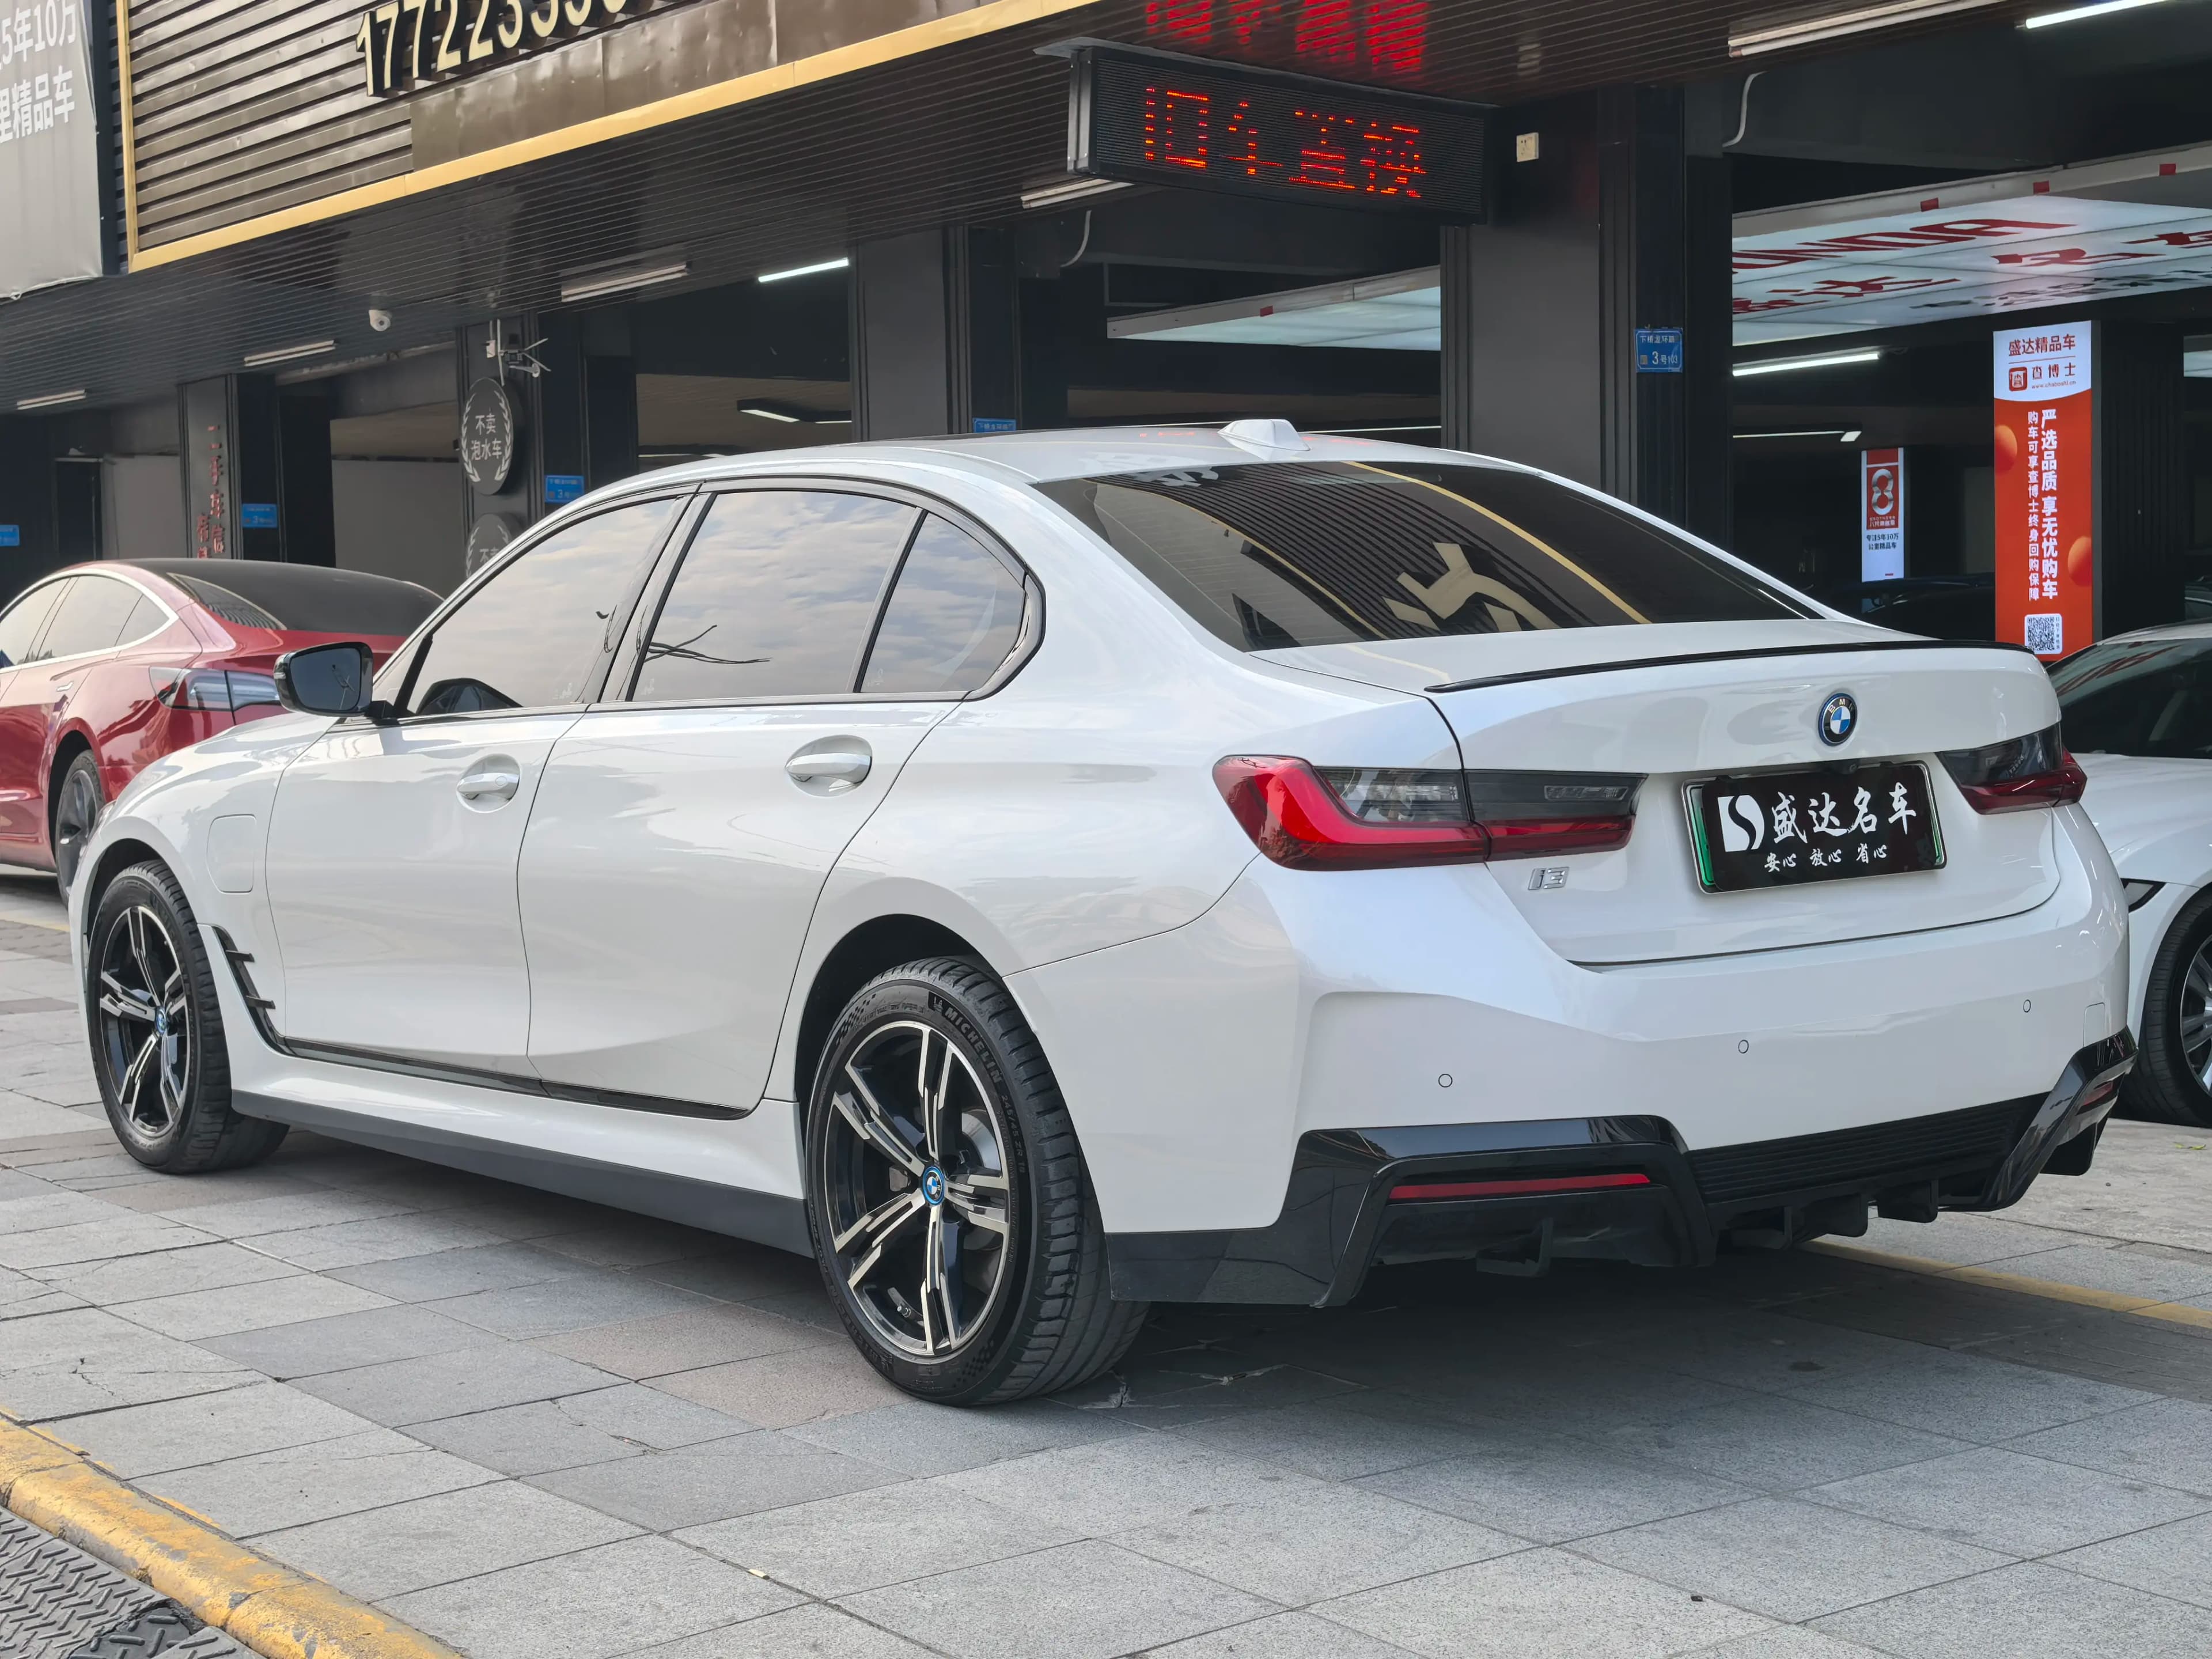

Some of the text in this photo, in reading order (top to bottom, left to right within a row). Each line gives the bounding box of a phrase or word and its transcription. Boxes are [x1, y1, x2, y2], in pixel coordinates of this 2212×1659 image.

[2009, 334, 2075, 357] 盛达精品车
[2032, 362, 2076, 380] 查博士
[475, 412, 497, 435] 不卖
[470, 437, 502, 461] 泡水车
[2041, 408, 2058, 600] 严选品质 享无忧购车
[1771, 782, 1916, 844] 盛达名车
[1764, 843, 1887, 872] 安心 放心 省心
[945, 1007, 1002, 1084] MICHELIN
